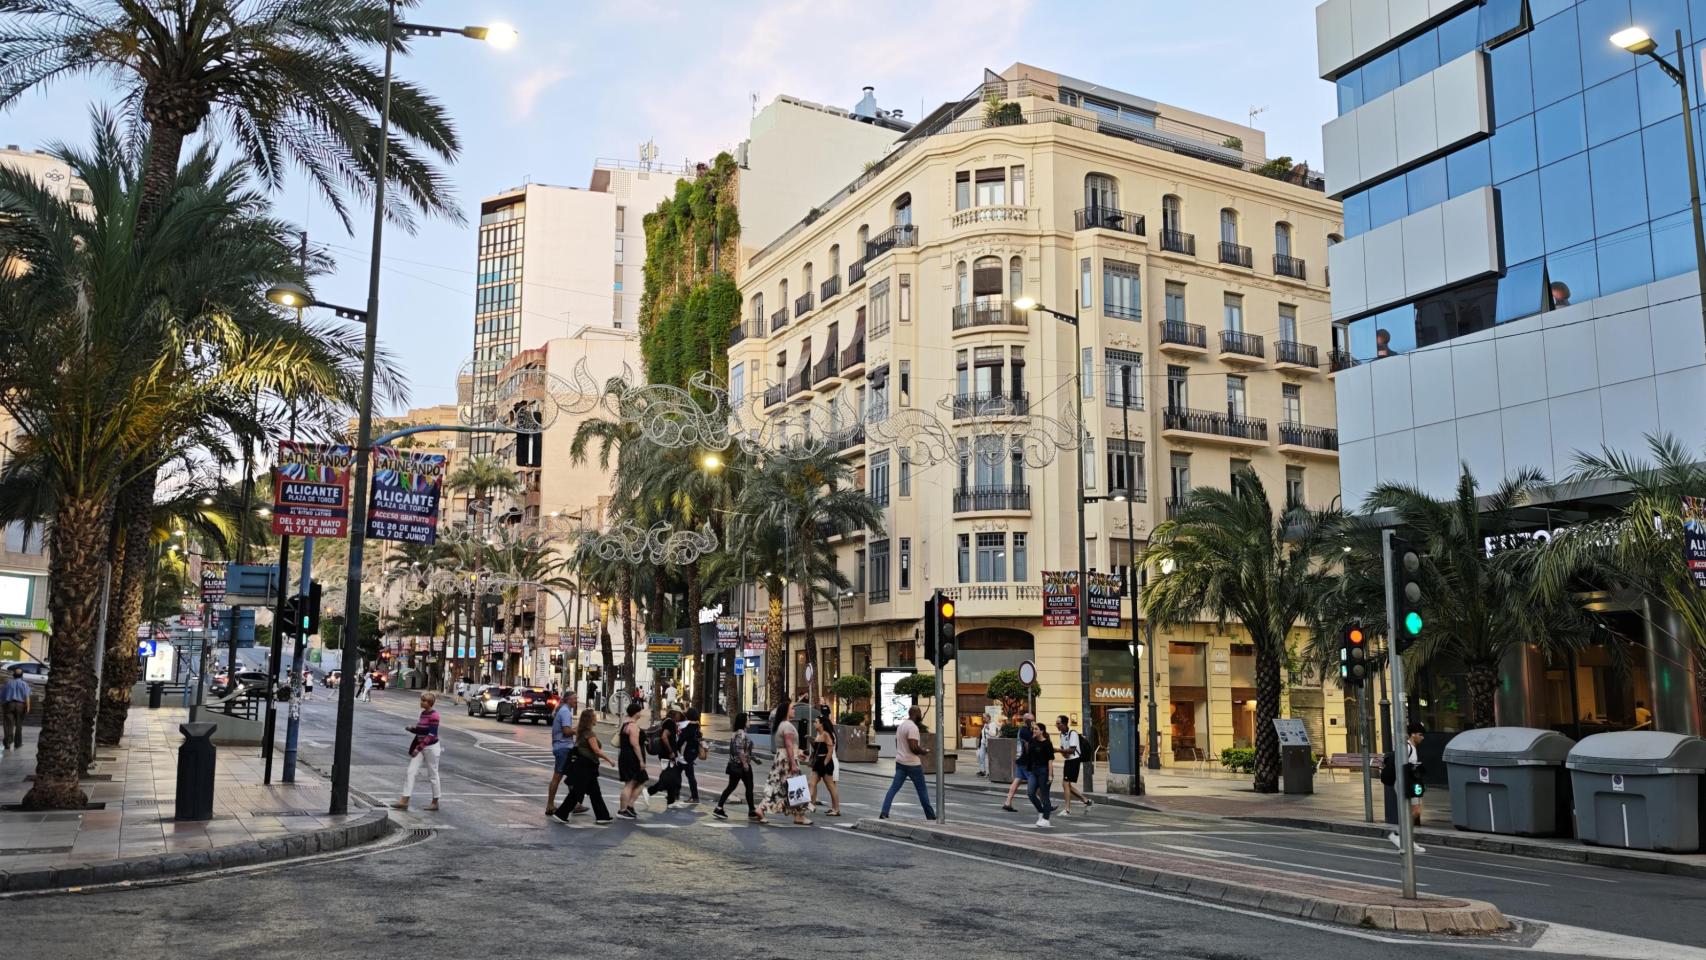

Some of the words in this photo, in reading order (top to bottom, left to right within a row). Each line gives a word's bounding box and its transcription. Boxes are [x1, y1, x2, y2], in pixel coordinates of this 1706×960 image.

[279, 451, 349, 467] LATINEANDO
[375, 459, 440, 476] LATINEANDO
[286, 484, 339, 498] ALICANTE
[374, 489, 435, 507] ALICANTE
[377, 501, 397, 509] PLAZA
[399, 503, 407, 511] DE
[410, 505, 429, 513] TOROS
[280, 517, 293, 525] DEL
[296, 518, 306, 526] 28
[309, 519, 318, 527] DE
[321, 520, 341, 528] MAYO
[375, 511, 399, 519] ACCESO
[401, 514, 430, 524] GRATUITO
[285, 525, 293, 533] AL
[315, 527, 337, 535] JUNIO
[372, 521, 385, 529] DEL
[400, 524, 409, 532] DE
[411, 526, 430, 535] MAYO
[376, 529, 385, 537] AL
[394, 531, 403, 539] DE
[405, 533, 426, 542] JUNIO
[1090, 597, 1119, 606] ALICANTE
[1095, 687, 1134, 699] SAONA
